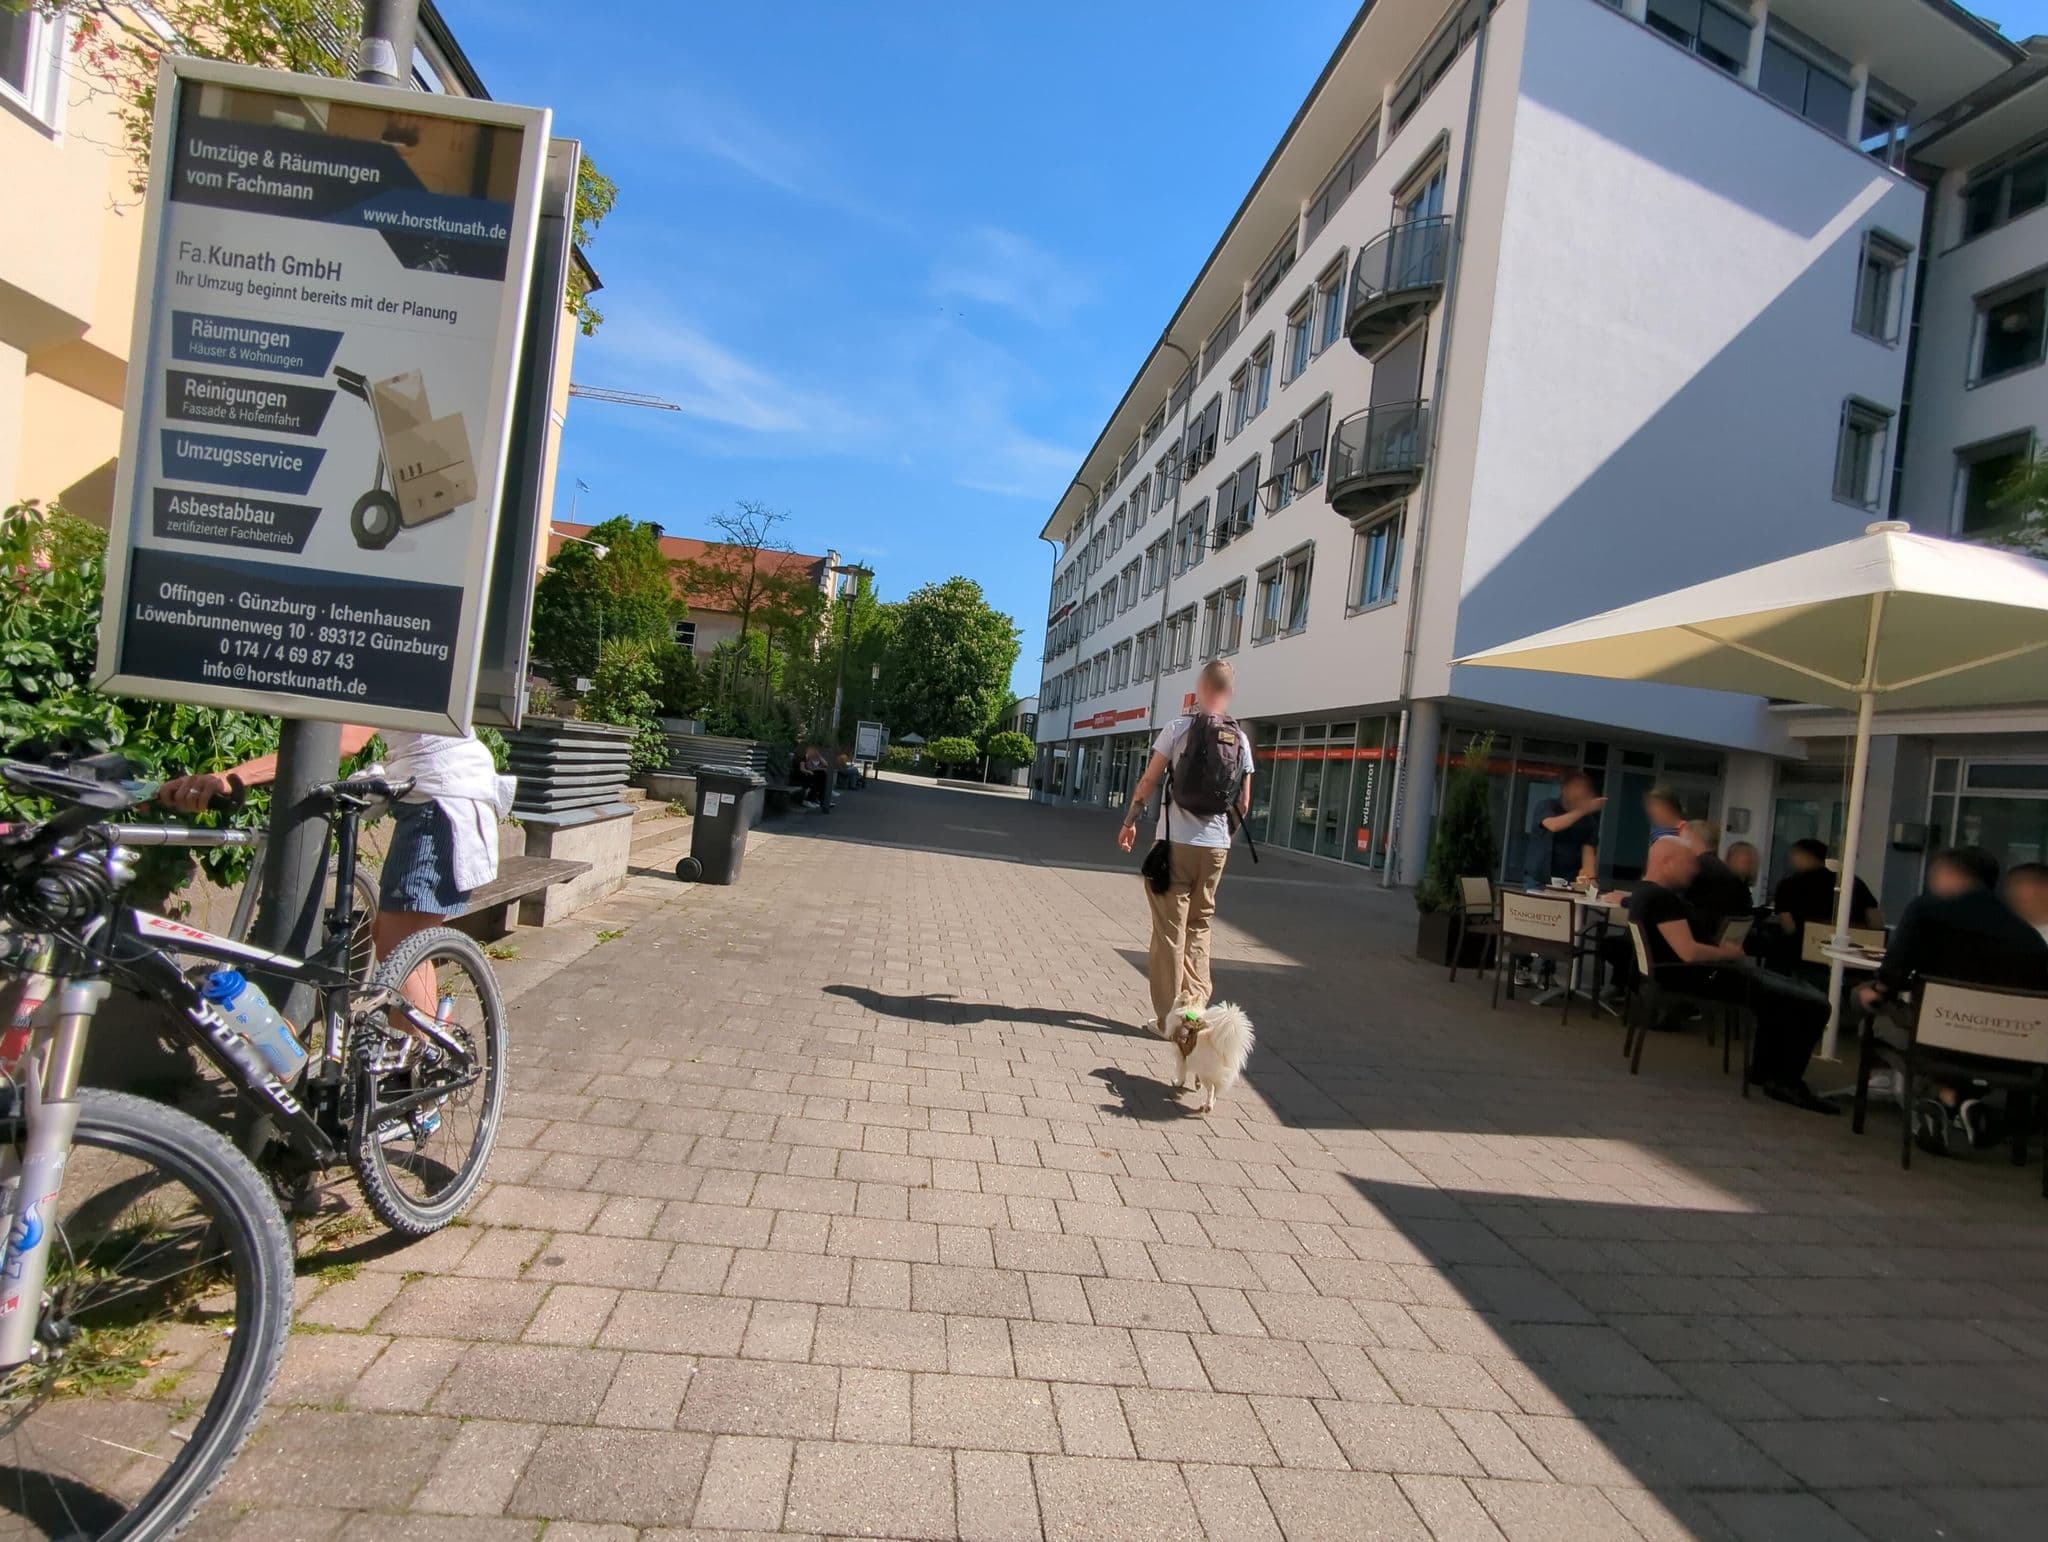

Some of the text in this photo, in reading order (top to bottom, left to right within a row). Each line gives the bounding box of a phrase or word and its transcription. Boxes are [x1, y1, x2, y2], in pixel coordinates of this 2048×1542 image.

[188, 139, 380, 184] Umzüge & Räumungen
[186, 168, 314, 200] vom Fachmann
[363, 209, 507, 239] www.horstkunath.de
[282, 255, 342, 281] GmbH
[175, 271, 458, 325] Ihr Umzug beginnt bereits mit der Planung
[191, 318, 290, 349] Räumungen
[188, 342, 304, 368] Häuser & Wohnungen
[184, 378, 288, 410] Reinigungen
[182, 401, 301, 428] Fassade & Hofeinfahrt
[176, 439, 303, 472] Umzugsservice
[168, 496, 275, 526] Asbestabbau
[166, 519, 294, 546] zertifizierter Fachbetrieb
[159, 582, 225, 608] Offingen
[238, 591, 317, 621] Günzburg
[329, 603, 431, 632] Ichenhausen
[135, 603, 283, 641] Löwenbrunnenweg
[288, 622, 306, 640] 10
[318, 626, 366, 648] 89312
[370, 632, 449, 661] Günzburg
[219, 638, 355, 670] 0 174 / 4 69 87 43
[202, 659, 368, 696] info@horstkunath.de
[1362, 763, 1376, 826] wüstenrot
[148, 918, 215, 942] EPIC
